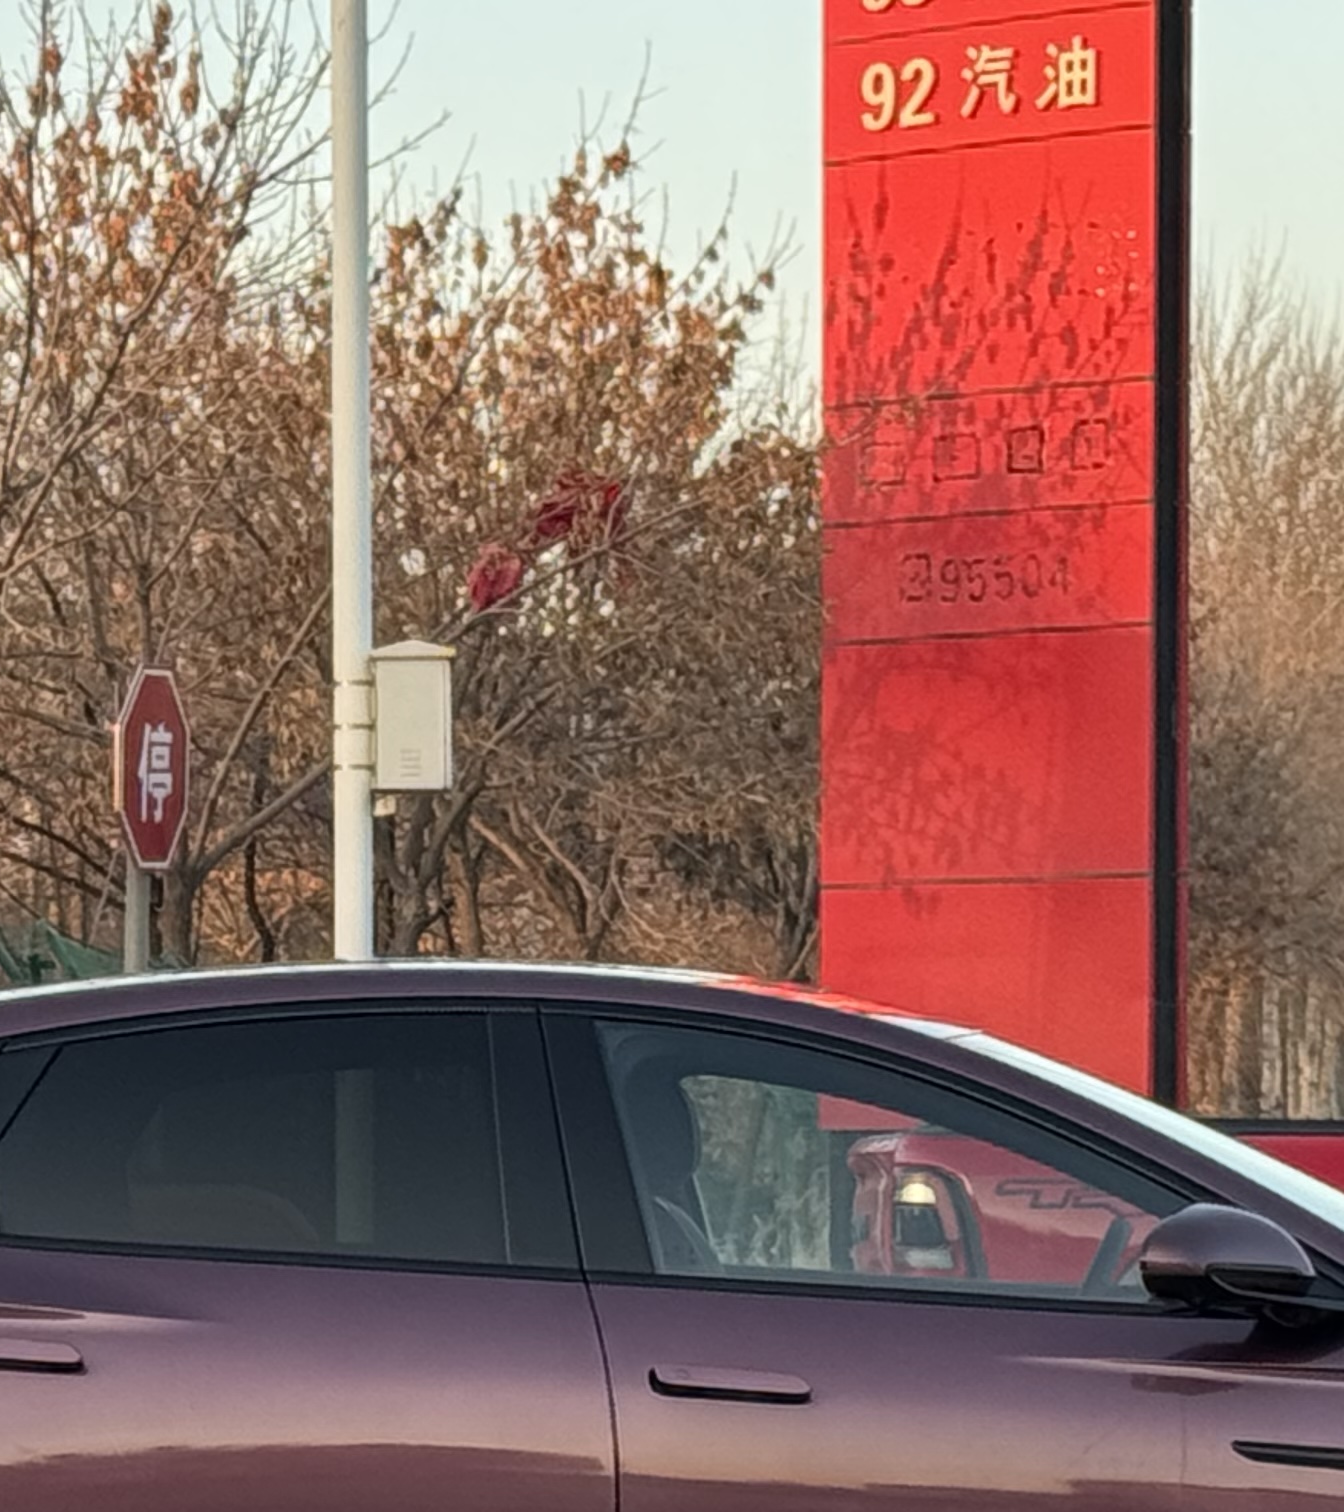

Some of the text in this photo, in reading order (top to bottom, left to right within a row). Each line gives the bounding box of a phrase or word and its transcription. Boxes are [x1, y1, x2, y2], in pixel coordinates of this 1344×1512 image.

[860, 35, 1097, 131] 92 汽油
[137, 721, 174, 823] 停
